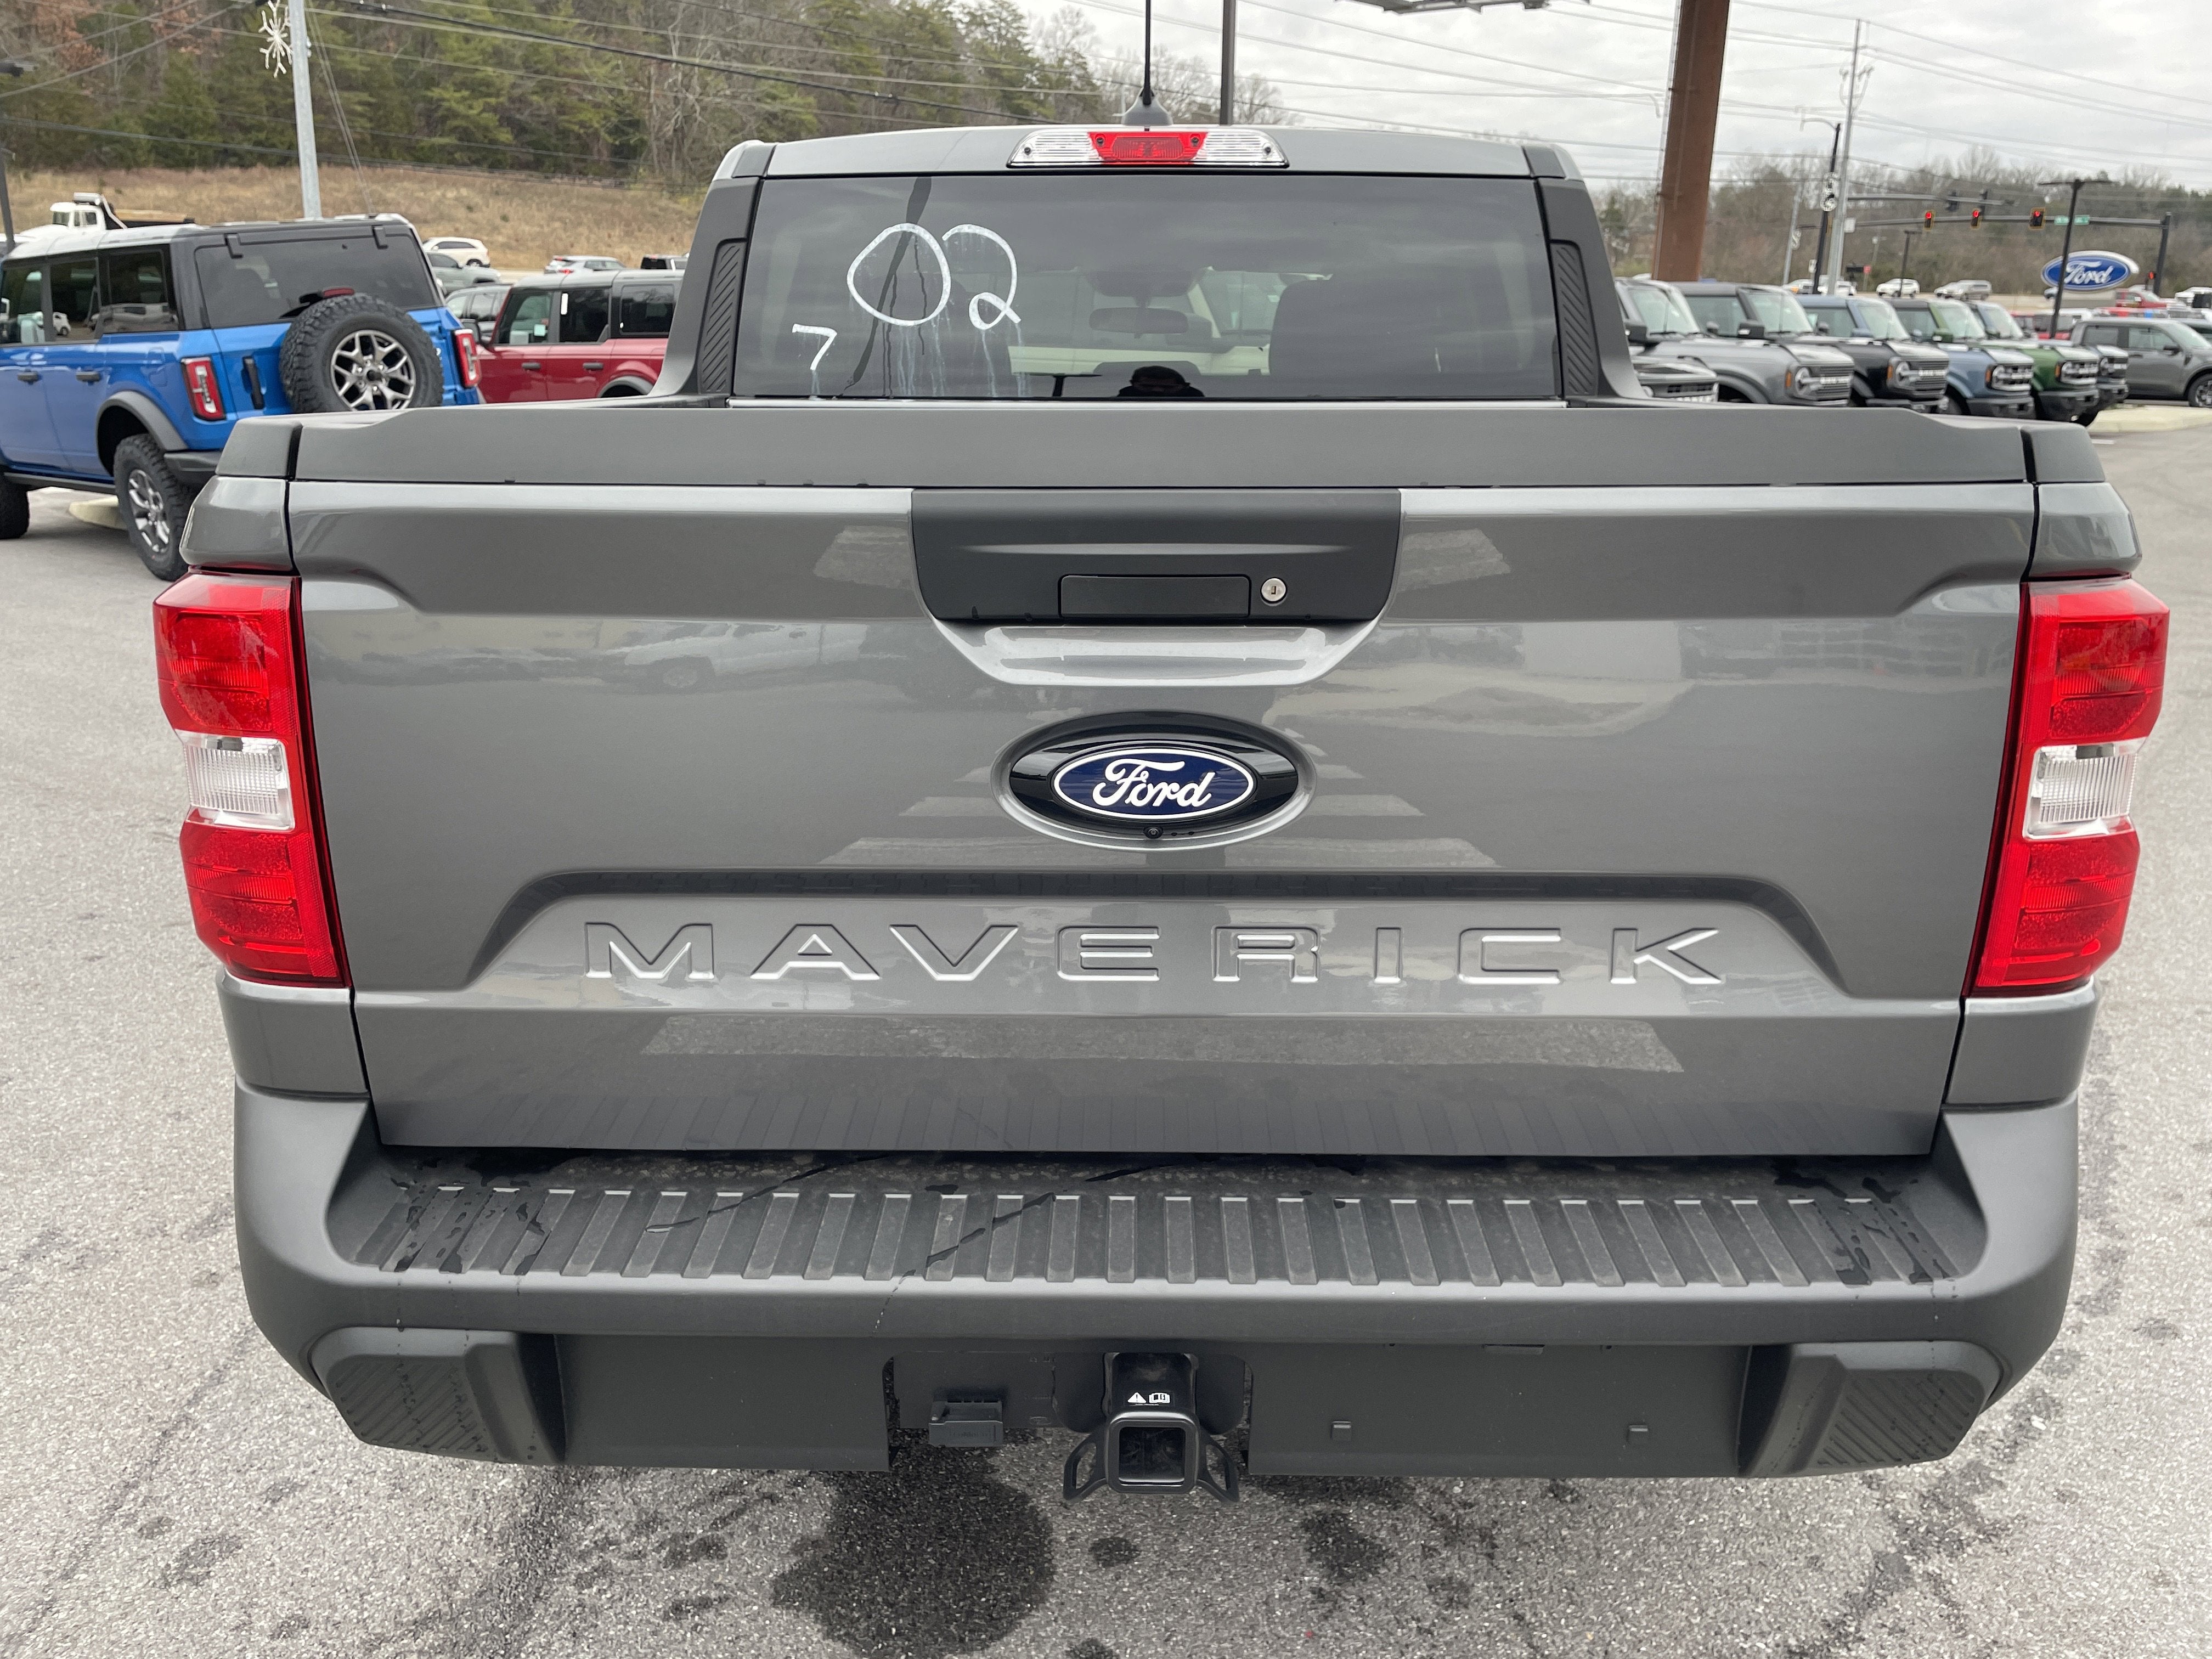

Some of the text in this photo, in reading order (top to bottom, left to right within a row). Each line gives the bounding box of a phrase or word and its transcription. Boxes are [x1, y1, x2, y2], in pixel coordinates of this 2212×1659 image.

[2064, 261, 2114, 284] Ford
[1092, 759, 1216, 808] Ford
[585, 923, 1722, 985] MAVERICK
